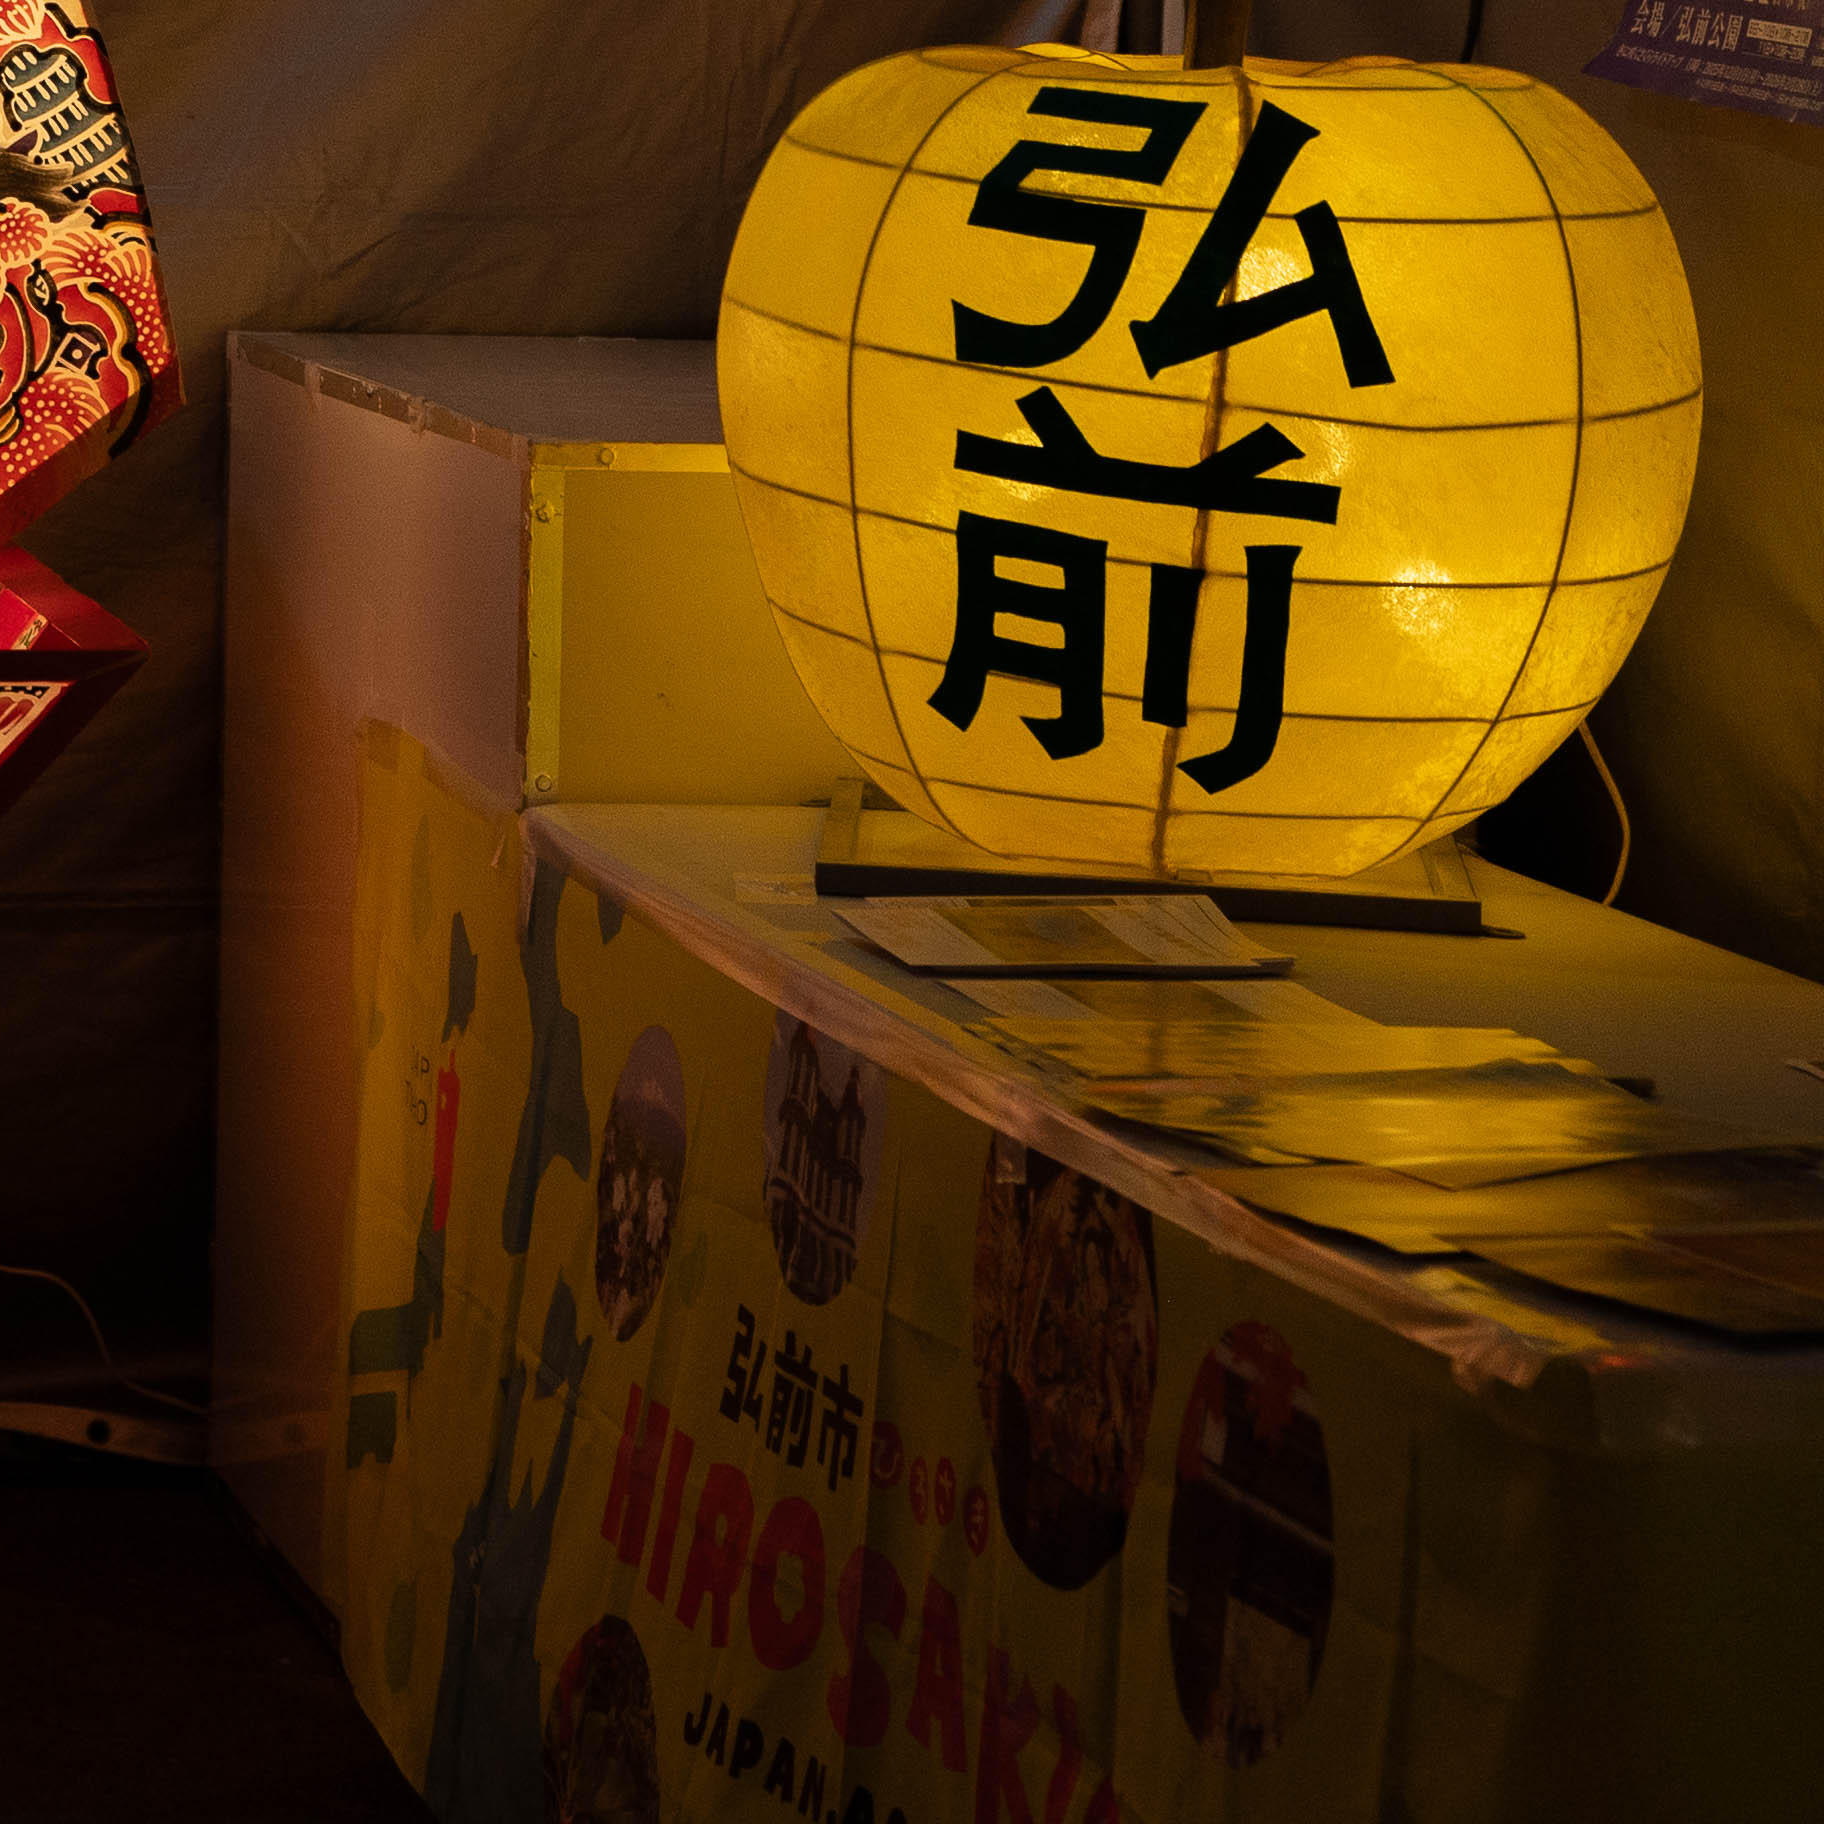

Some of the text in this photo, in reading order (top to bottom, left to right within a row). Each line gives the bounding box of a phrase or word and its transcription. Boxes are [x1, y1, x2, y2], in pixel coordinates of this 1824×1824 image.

[926, 85, 1396, 796] 弘前
[719, 1302, 864, 1492] 弘前市
